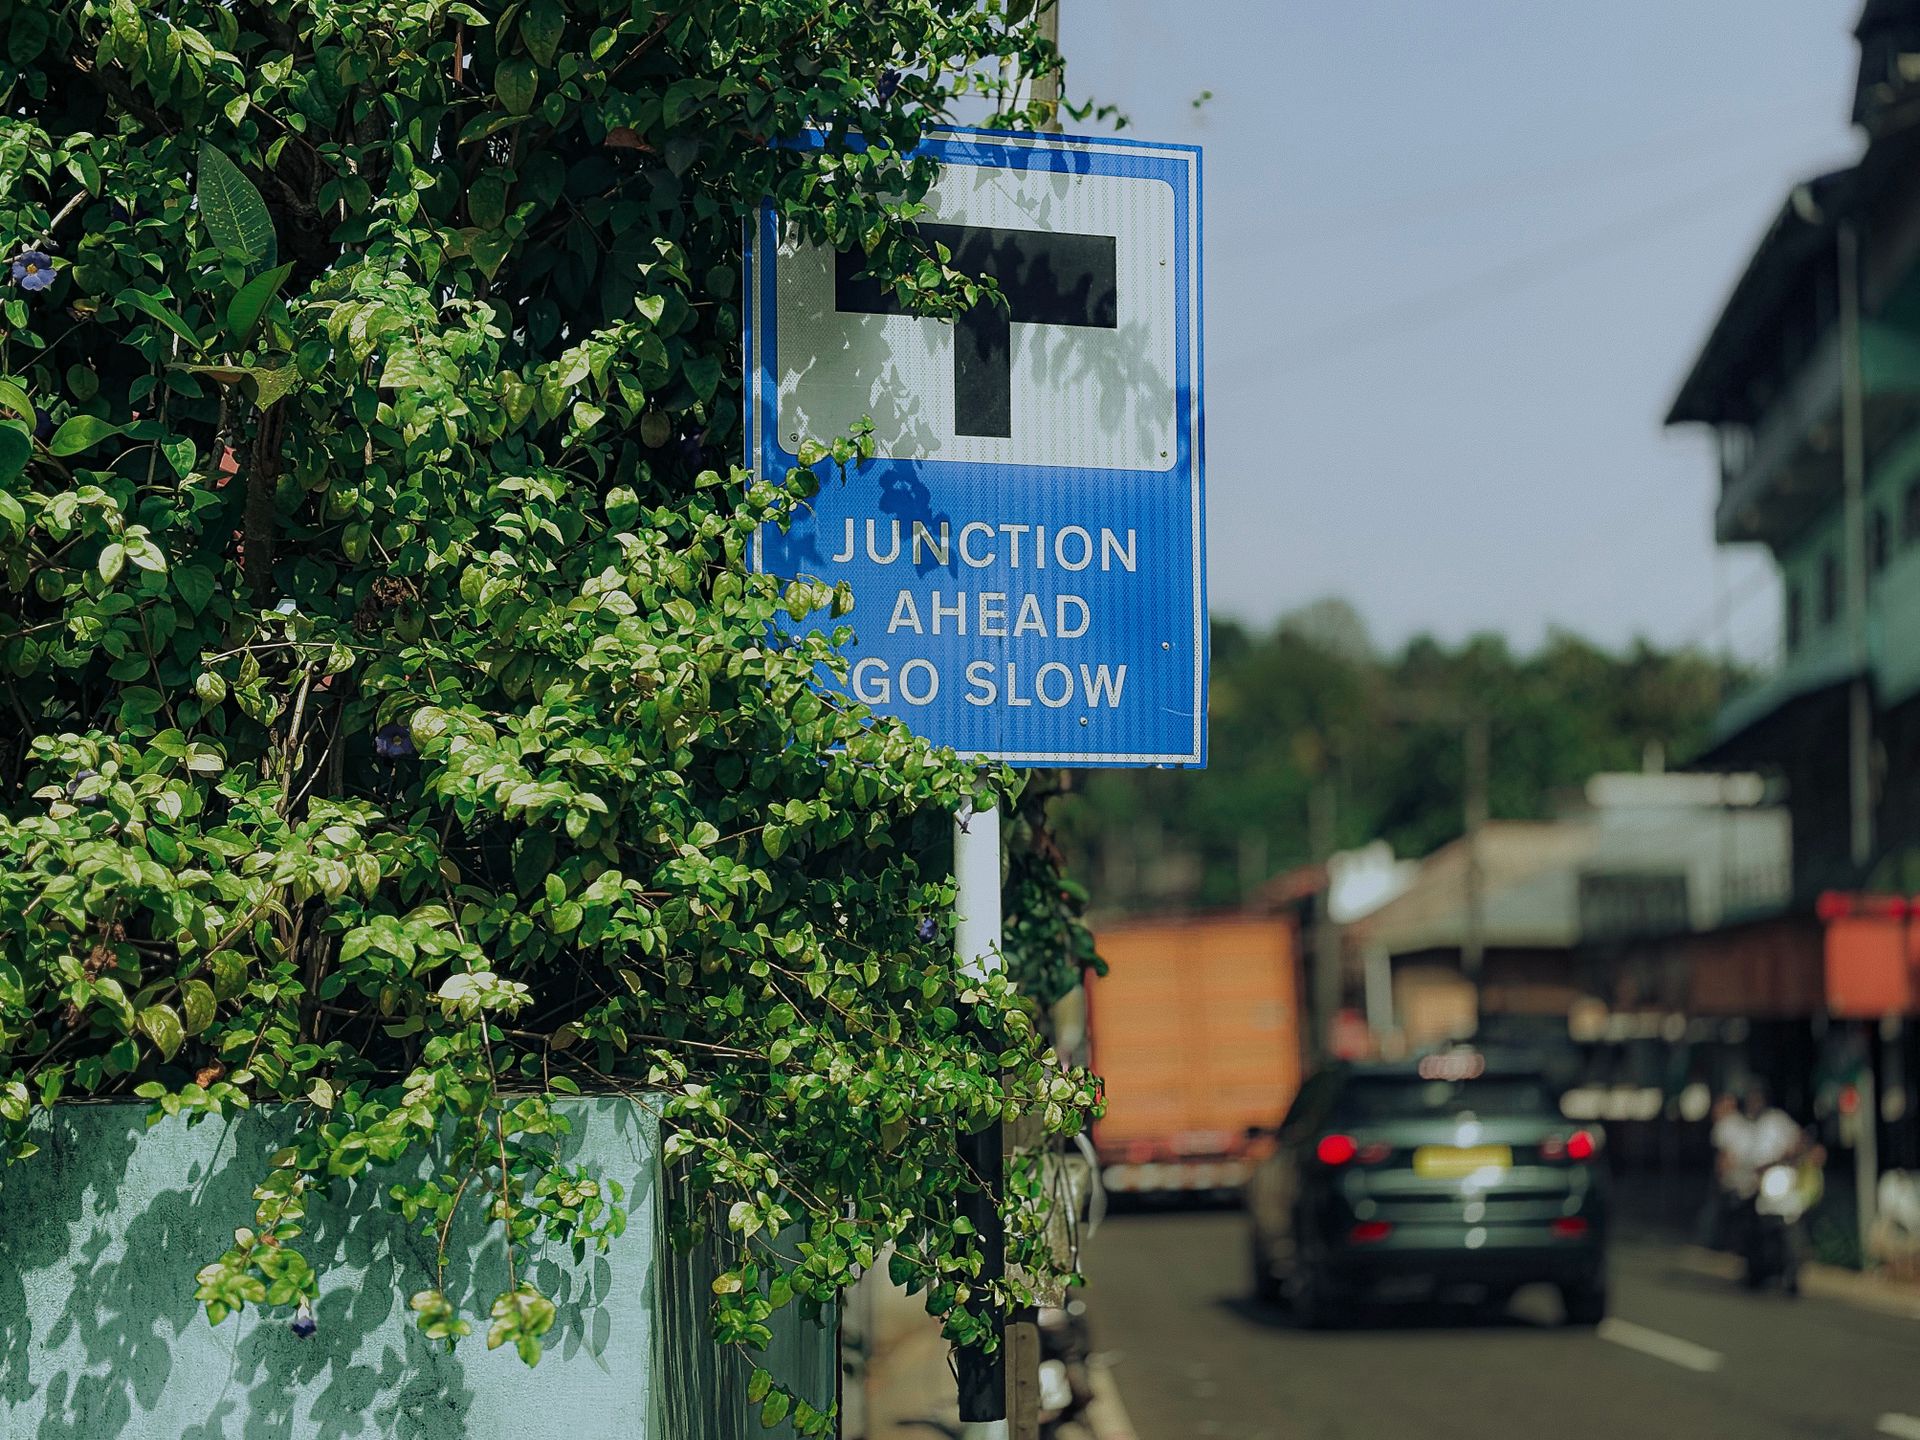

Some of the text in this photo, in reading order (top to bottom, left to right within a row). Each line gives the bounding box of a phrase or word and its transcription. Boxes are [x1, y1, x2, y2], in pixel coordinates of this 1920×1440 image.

[832, 518, 1137, 572] JUNCTION
[887, 590, 1091, 638] AHEAD
[852, 657, 1127, 708] GO SLOW
